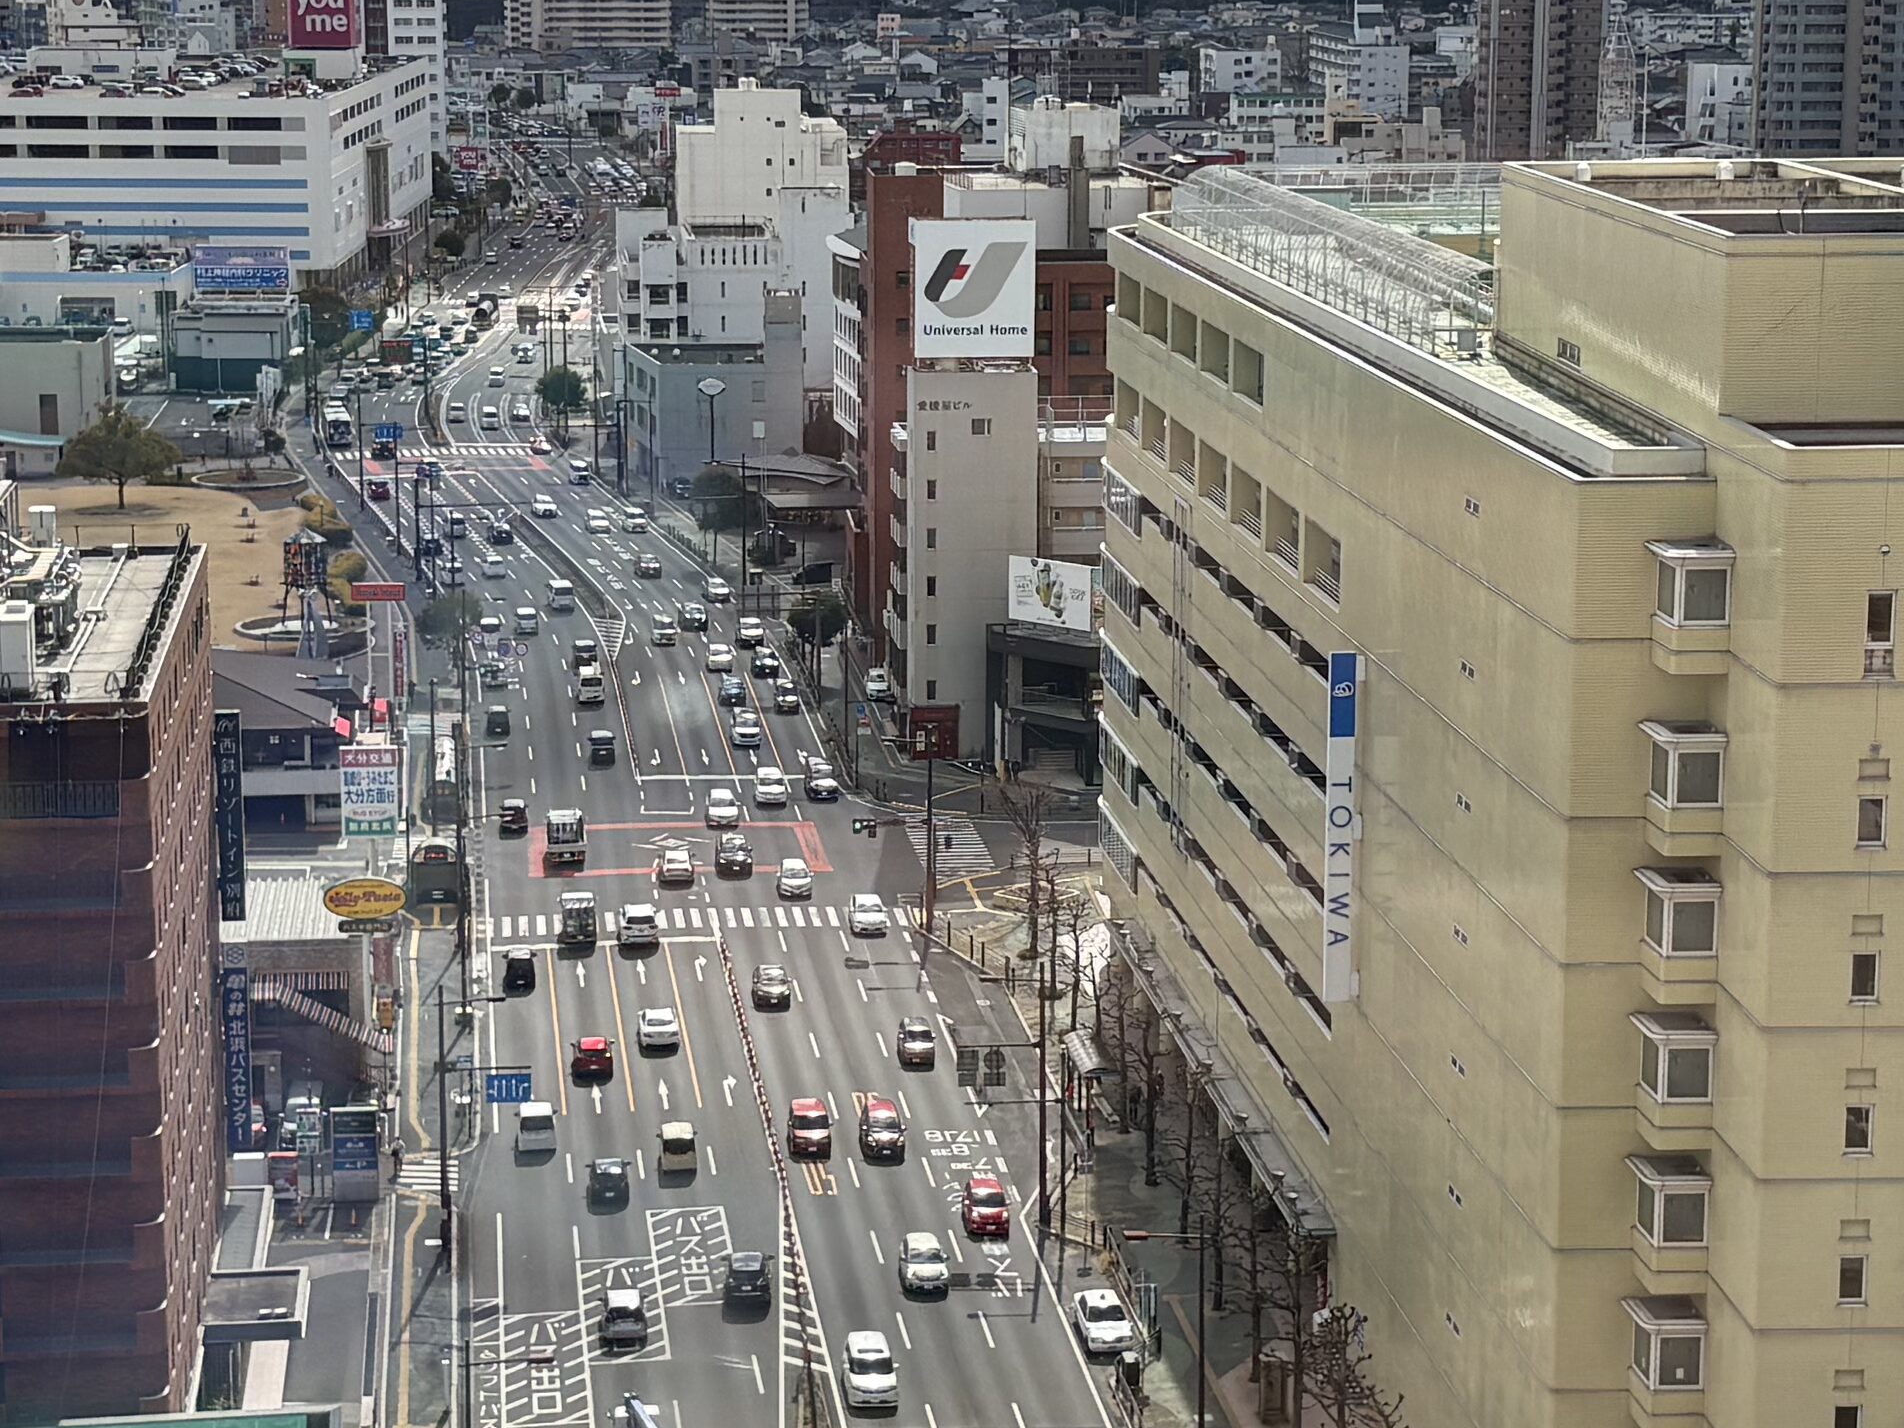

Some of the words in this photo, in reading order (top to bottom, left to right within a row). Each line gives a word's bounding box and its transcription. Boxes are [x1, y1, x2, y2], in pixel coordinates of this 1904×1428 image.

[305, 13, 348, 32] me
[923, 324, 984, 336] Universal
[990, 324, 1028, 336] Home
[1327, 776, 1353, 947] TOKIWA
[228, 1019, 247, 1142] 北浜バスセンター
[675, 1213, 715, 1296] バス出口
